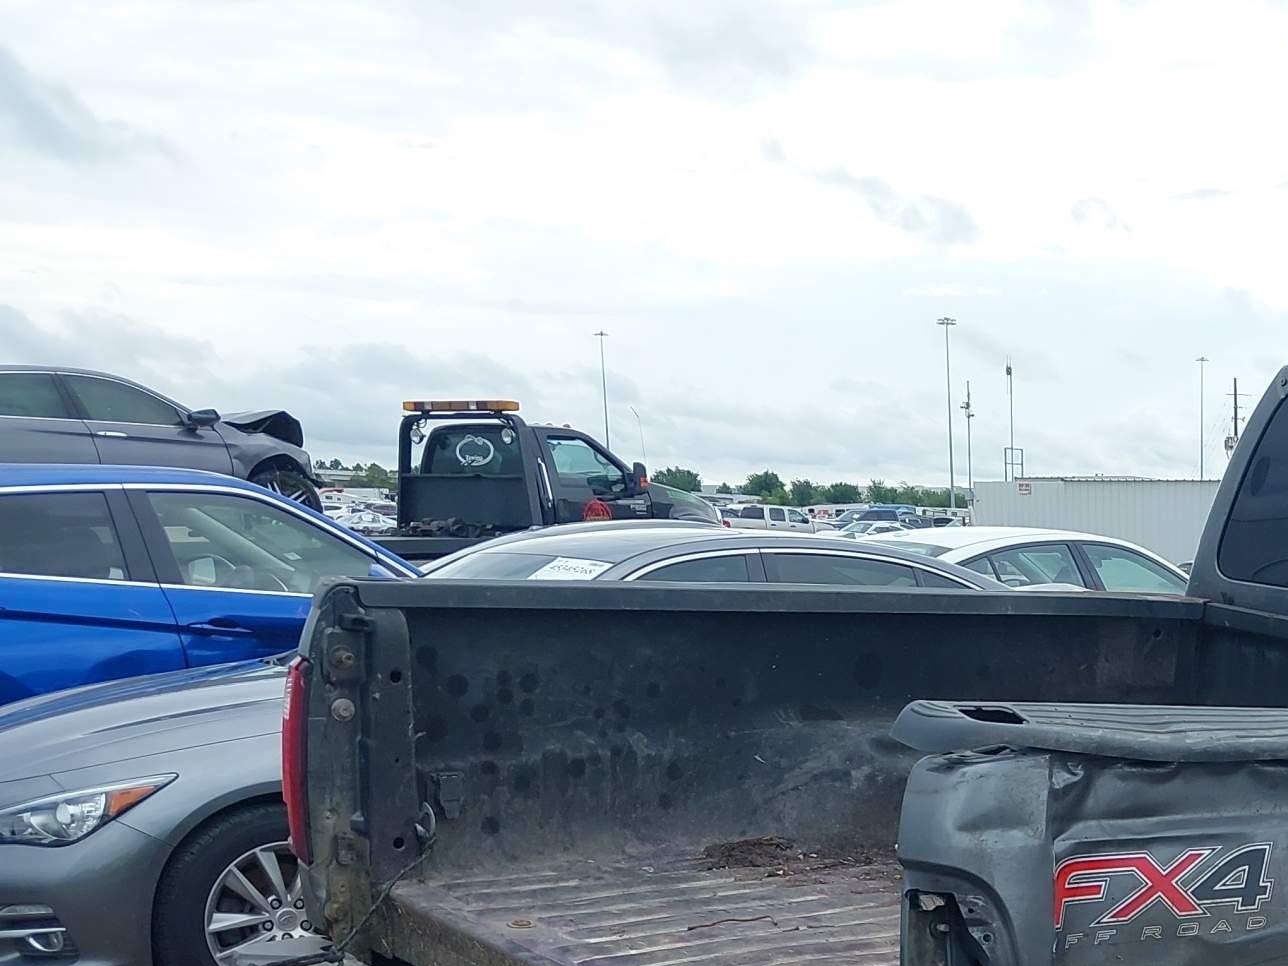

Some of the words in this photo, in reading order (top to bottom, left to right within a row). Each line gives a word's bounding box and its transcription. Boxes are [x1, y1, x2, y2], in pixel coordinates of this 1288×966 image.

[1053, 841, 1274, 929] FX4
[1053, 929, 1117, 952] FF
[1140, 915, 1268, 941] ROAD
